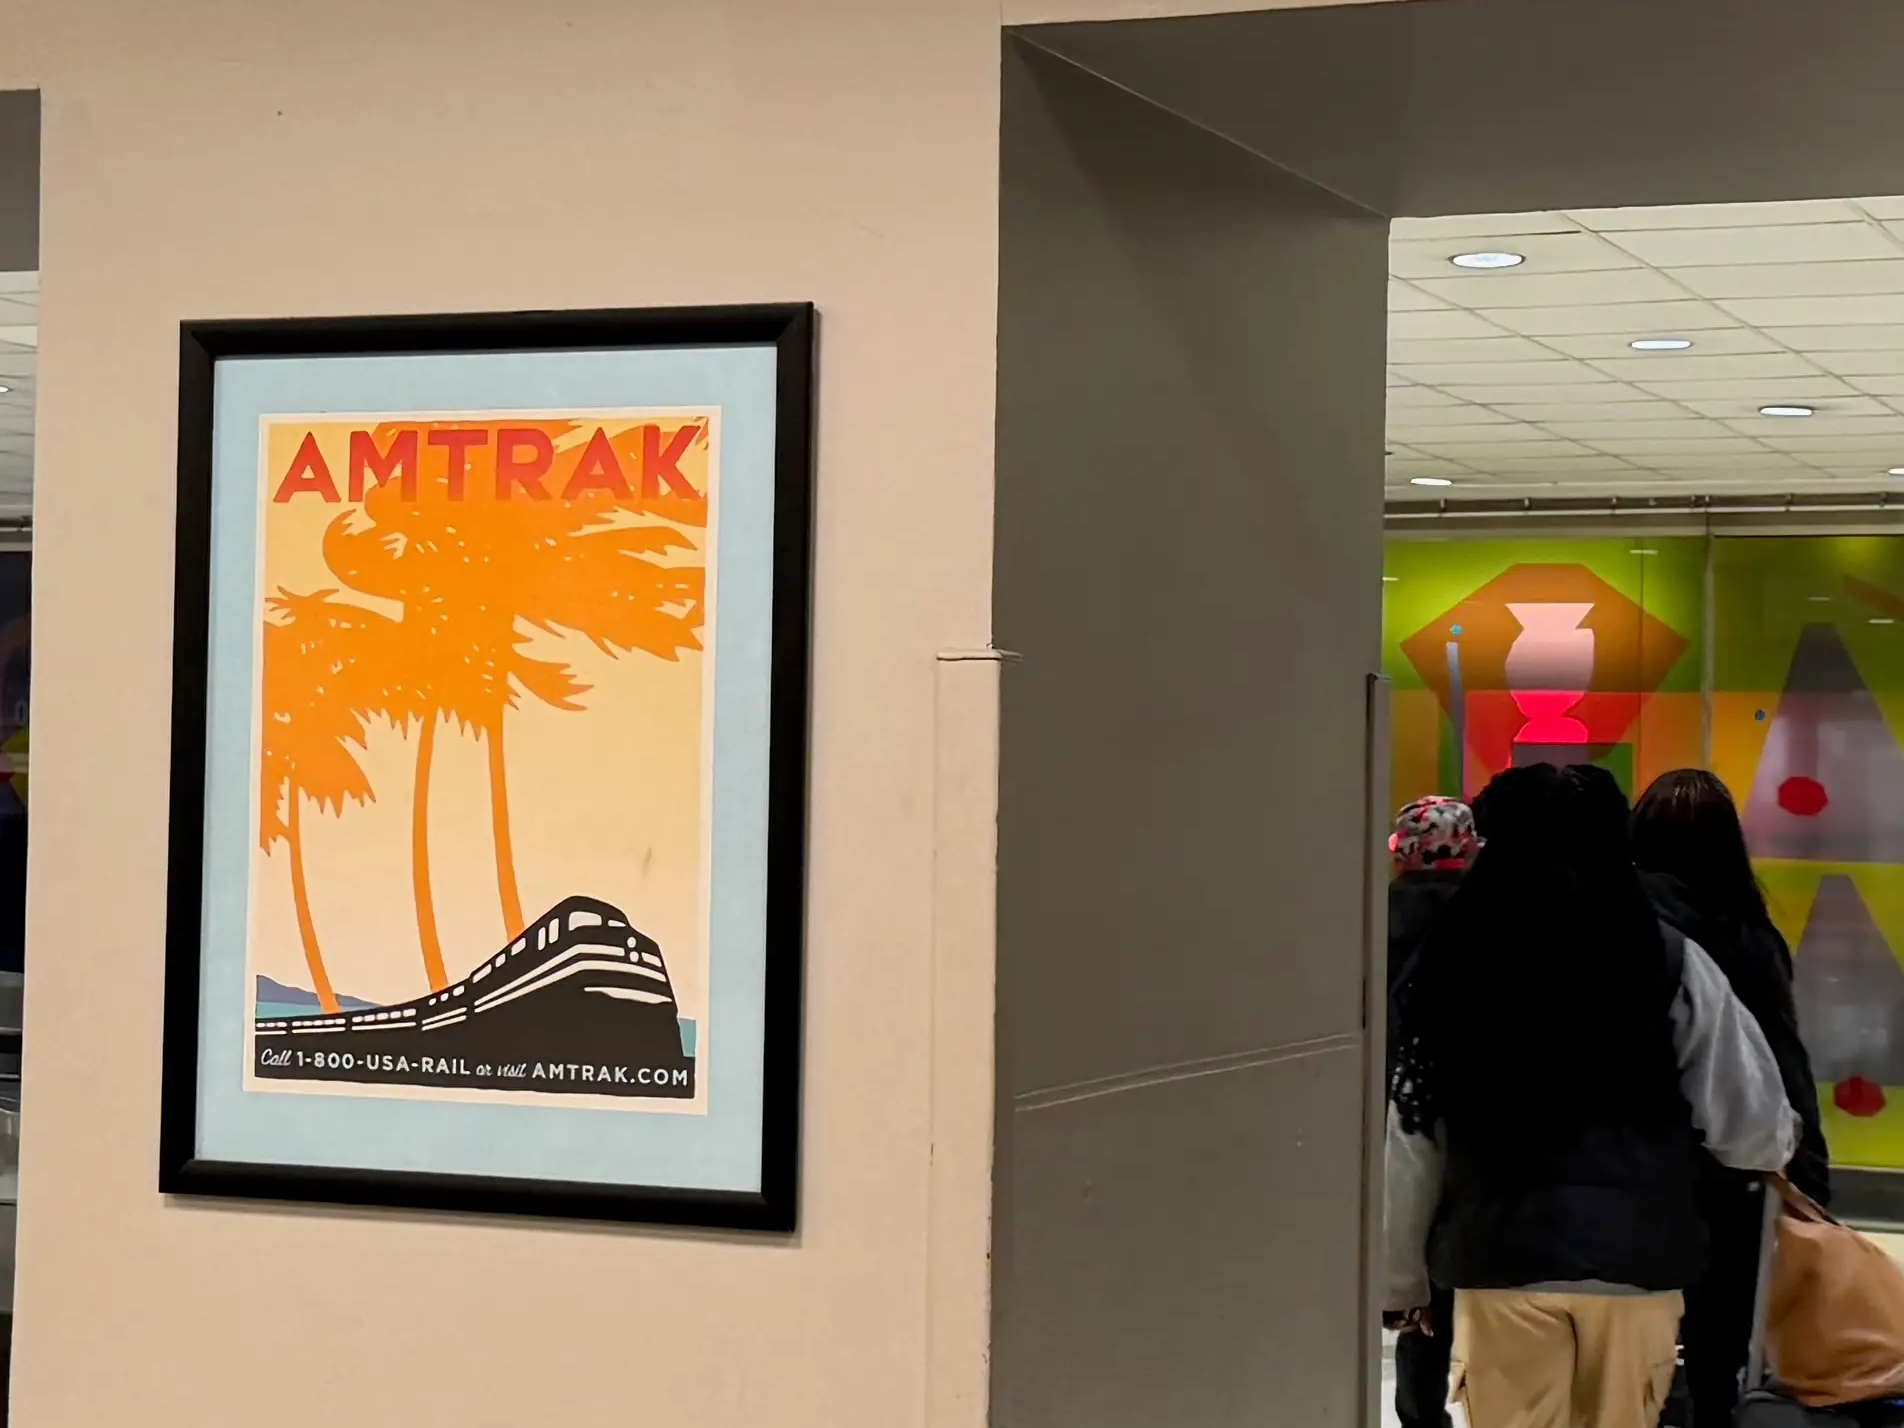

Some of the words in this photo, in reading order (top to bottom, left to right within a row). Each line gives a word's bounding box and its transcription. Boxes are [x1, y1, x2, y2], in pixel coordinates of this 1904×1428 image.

[273, 425, 702, 503] AMTRAK
[260, 1048, 293, 1067] Call
[296, 1051, 471, 1076] 1-800-USA-RAIL
[476, 1064, 493, 1077] or
[497, 1063, 527, 1078] visit
[532, 1062, 688, 1087] AMTRAK.COM
